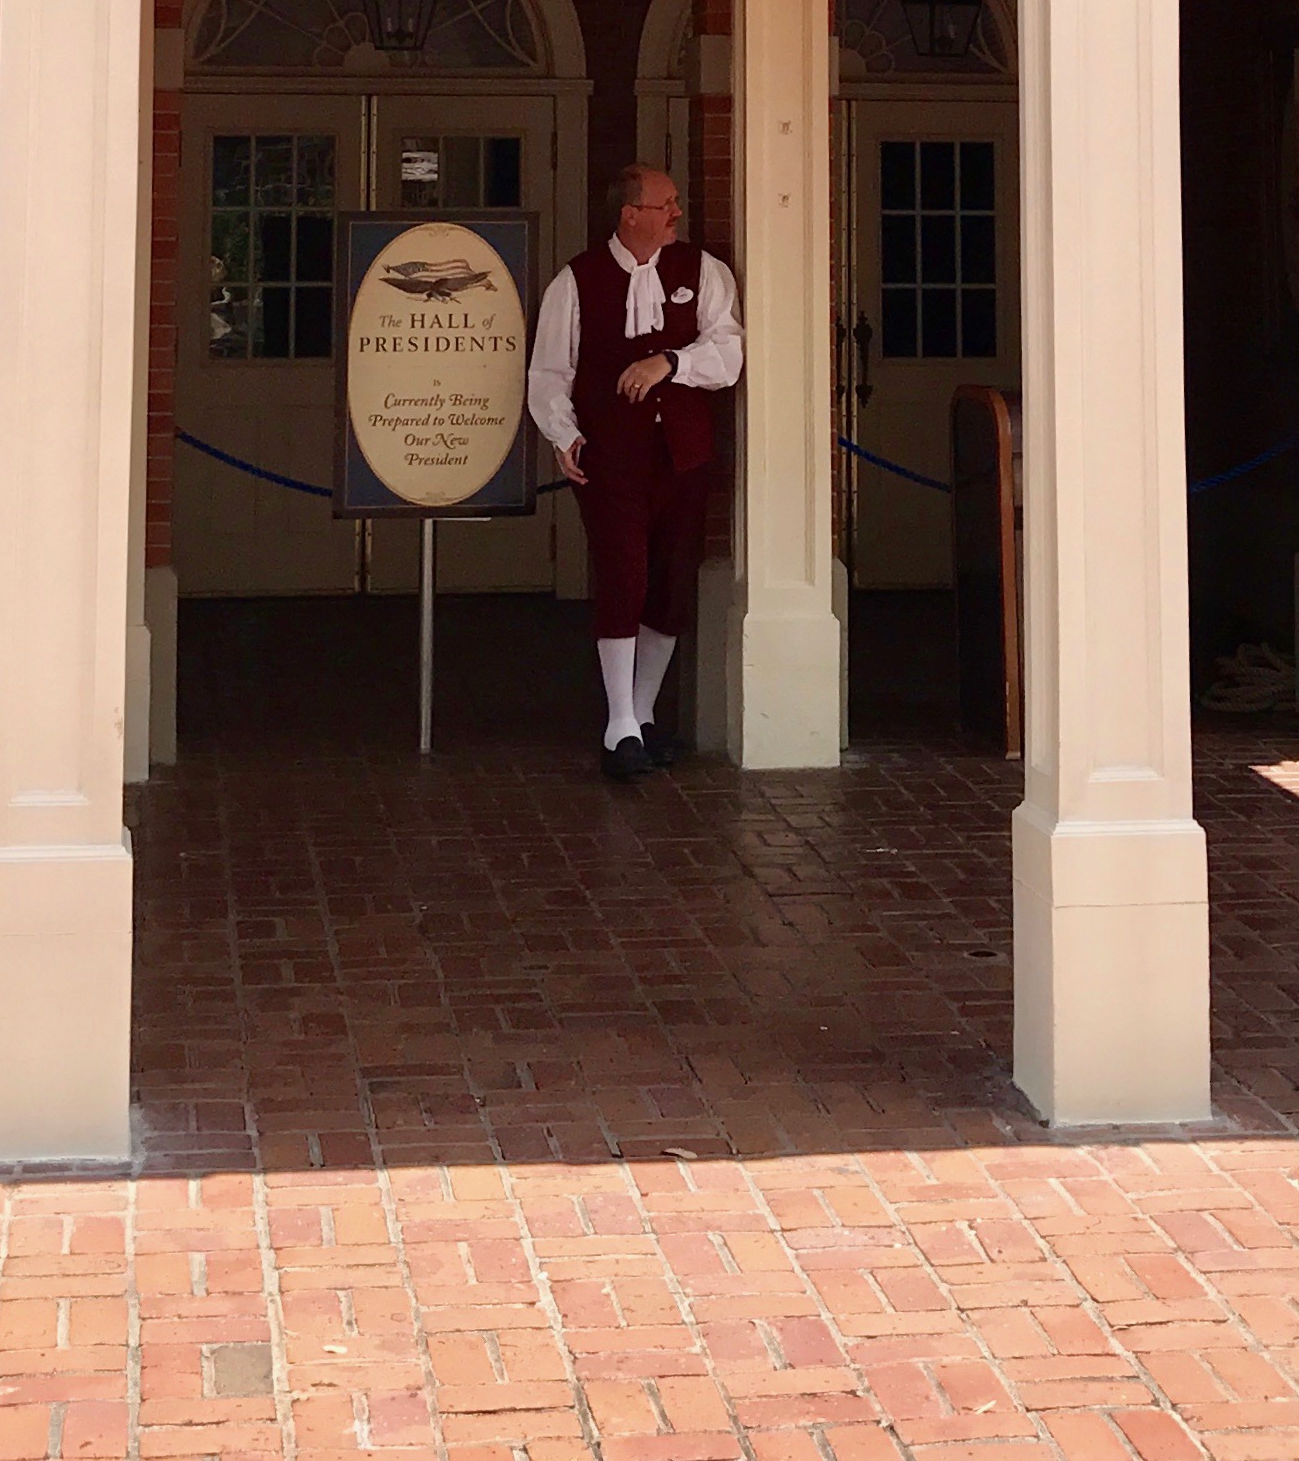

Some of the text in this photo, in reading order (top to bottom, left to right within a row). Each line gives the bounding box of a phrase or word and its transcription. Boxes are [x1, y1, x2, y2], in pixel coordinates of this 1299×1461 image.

[379, 313, 496, 330] The HALL of
[359, 336, 517, 353] PRESIDENTS
[384, 393, 490, 410] Currently Being
[368, 413, 506, 431] Prepared to Welcome
[404, 433, 470, 449] Our New
[404, 453, 469, 466] President
